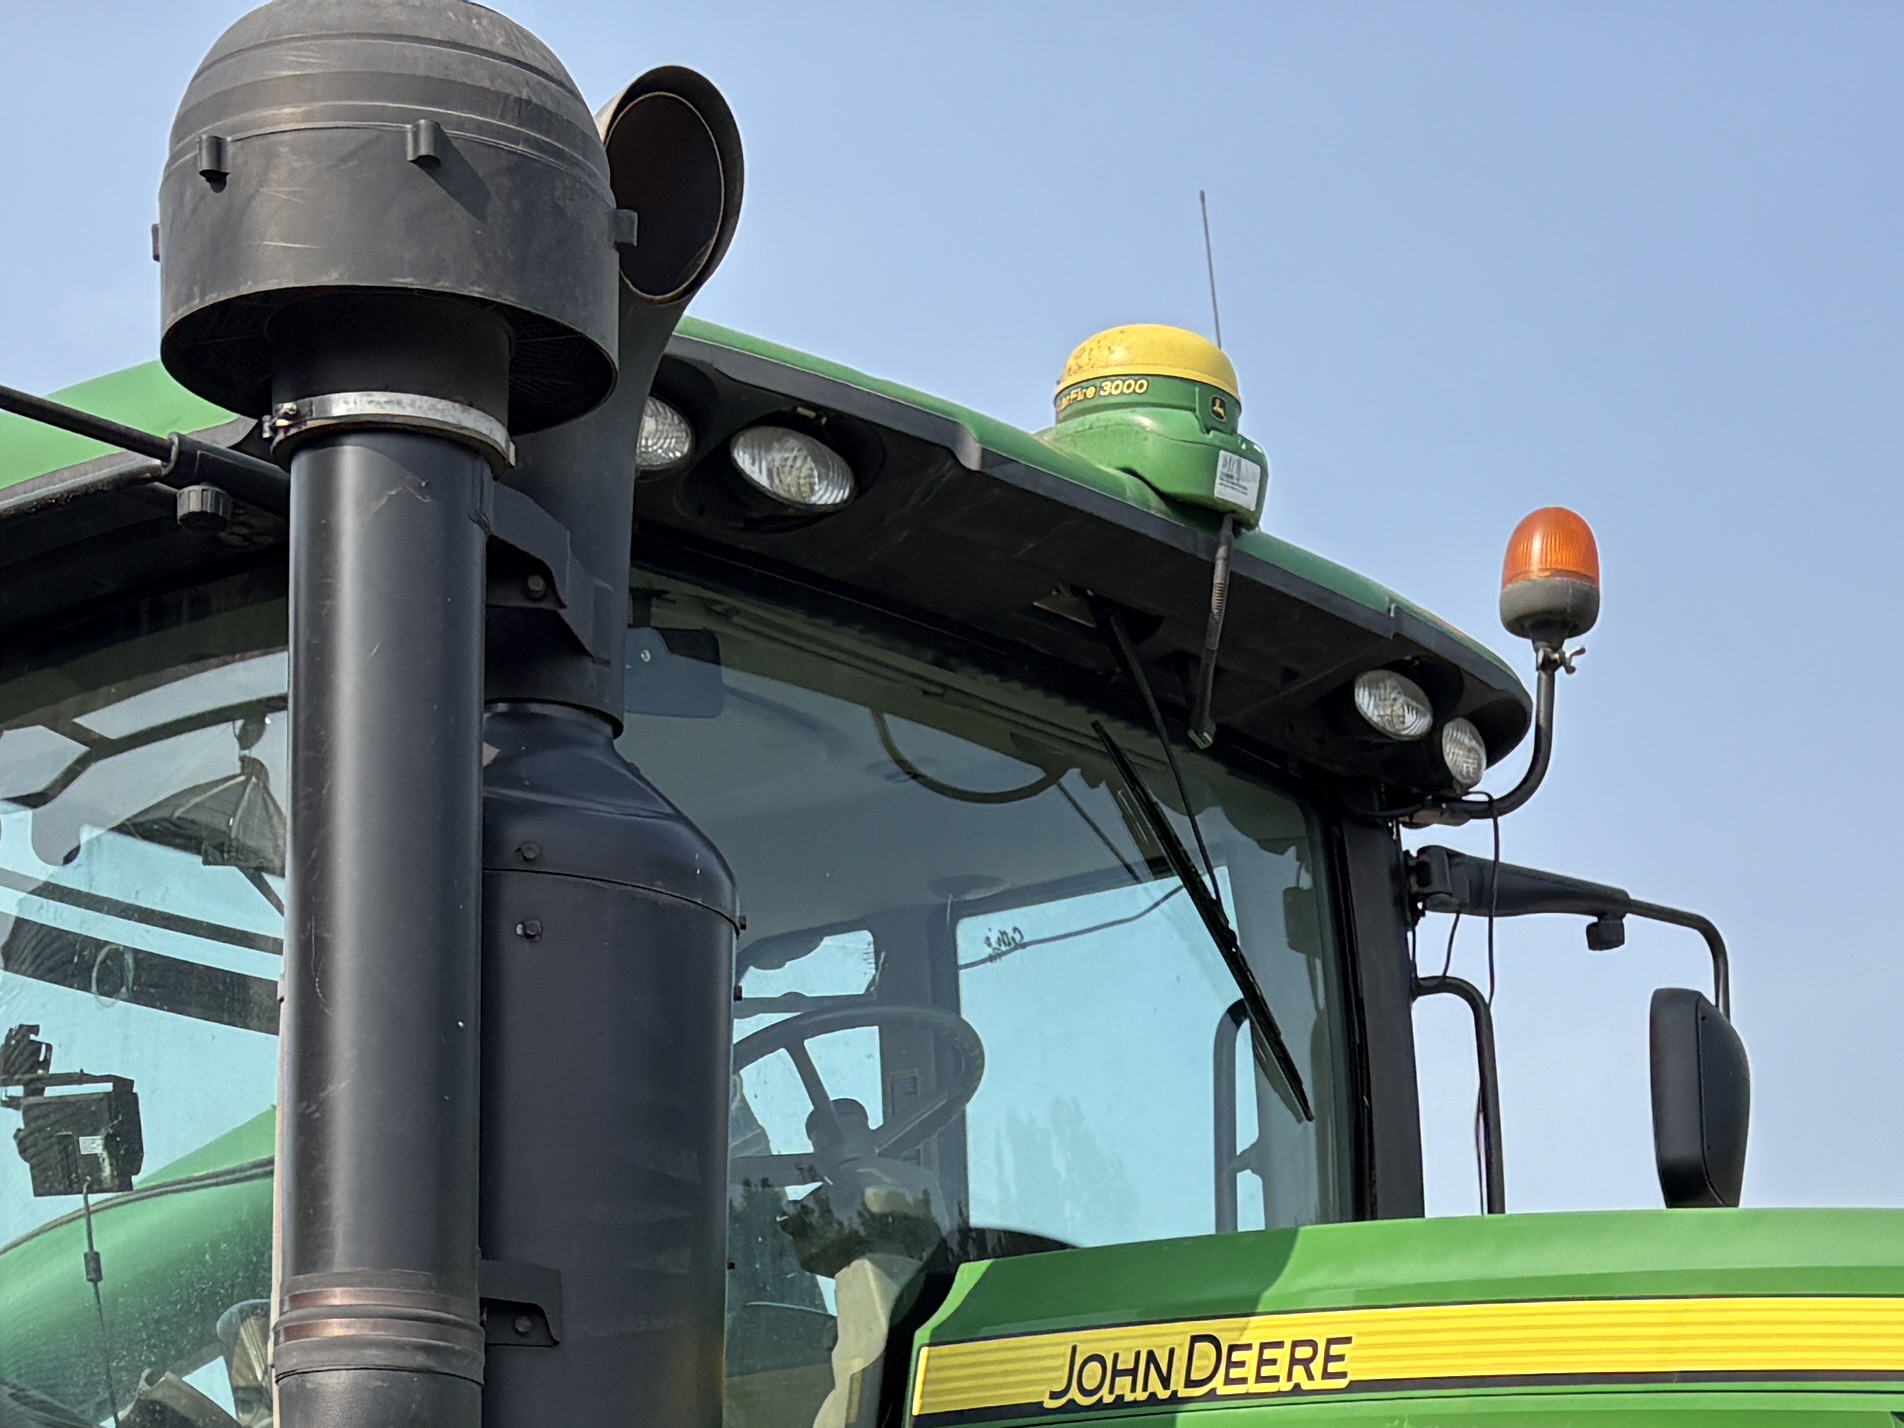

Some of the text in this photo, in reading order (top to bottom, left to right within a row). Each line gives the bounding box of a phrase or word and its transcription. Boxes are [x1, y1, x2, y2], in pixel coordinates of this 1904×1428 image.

[1099, 379, 1148, 396] 3000
[1048, 1333, 1353, 1402] JOHN DEERE
